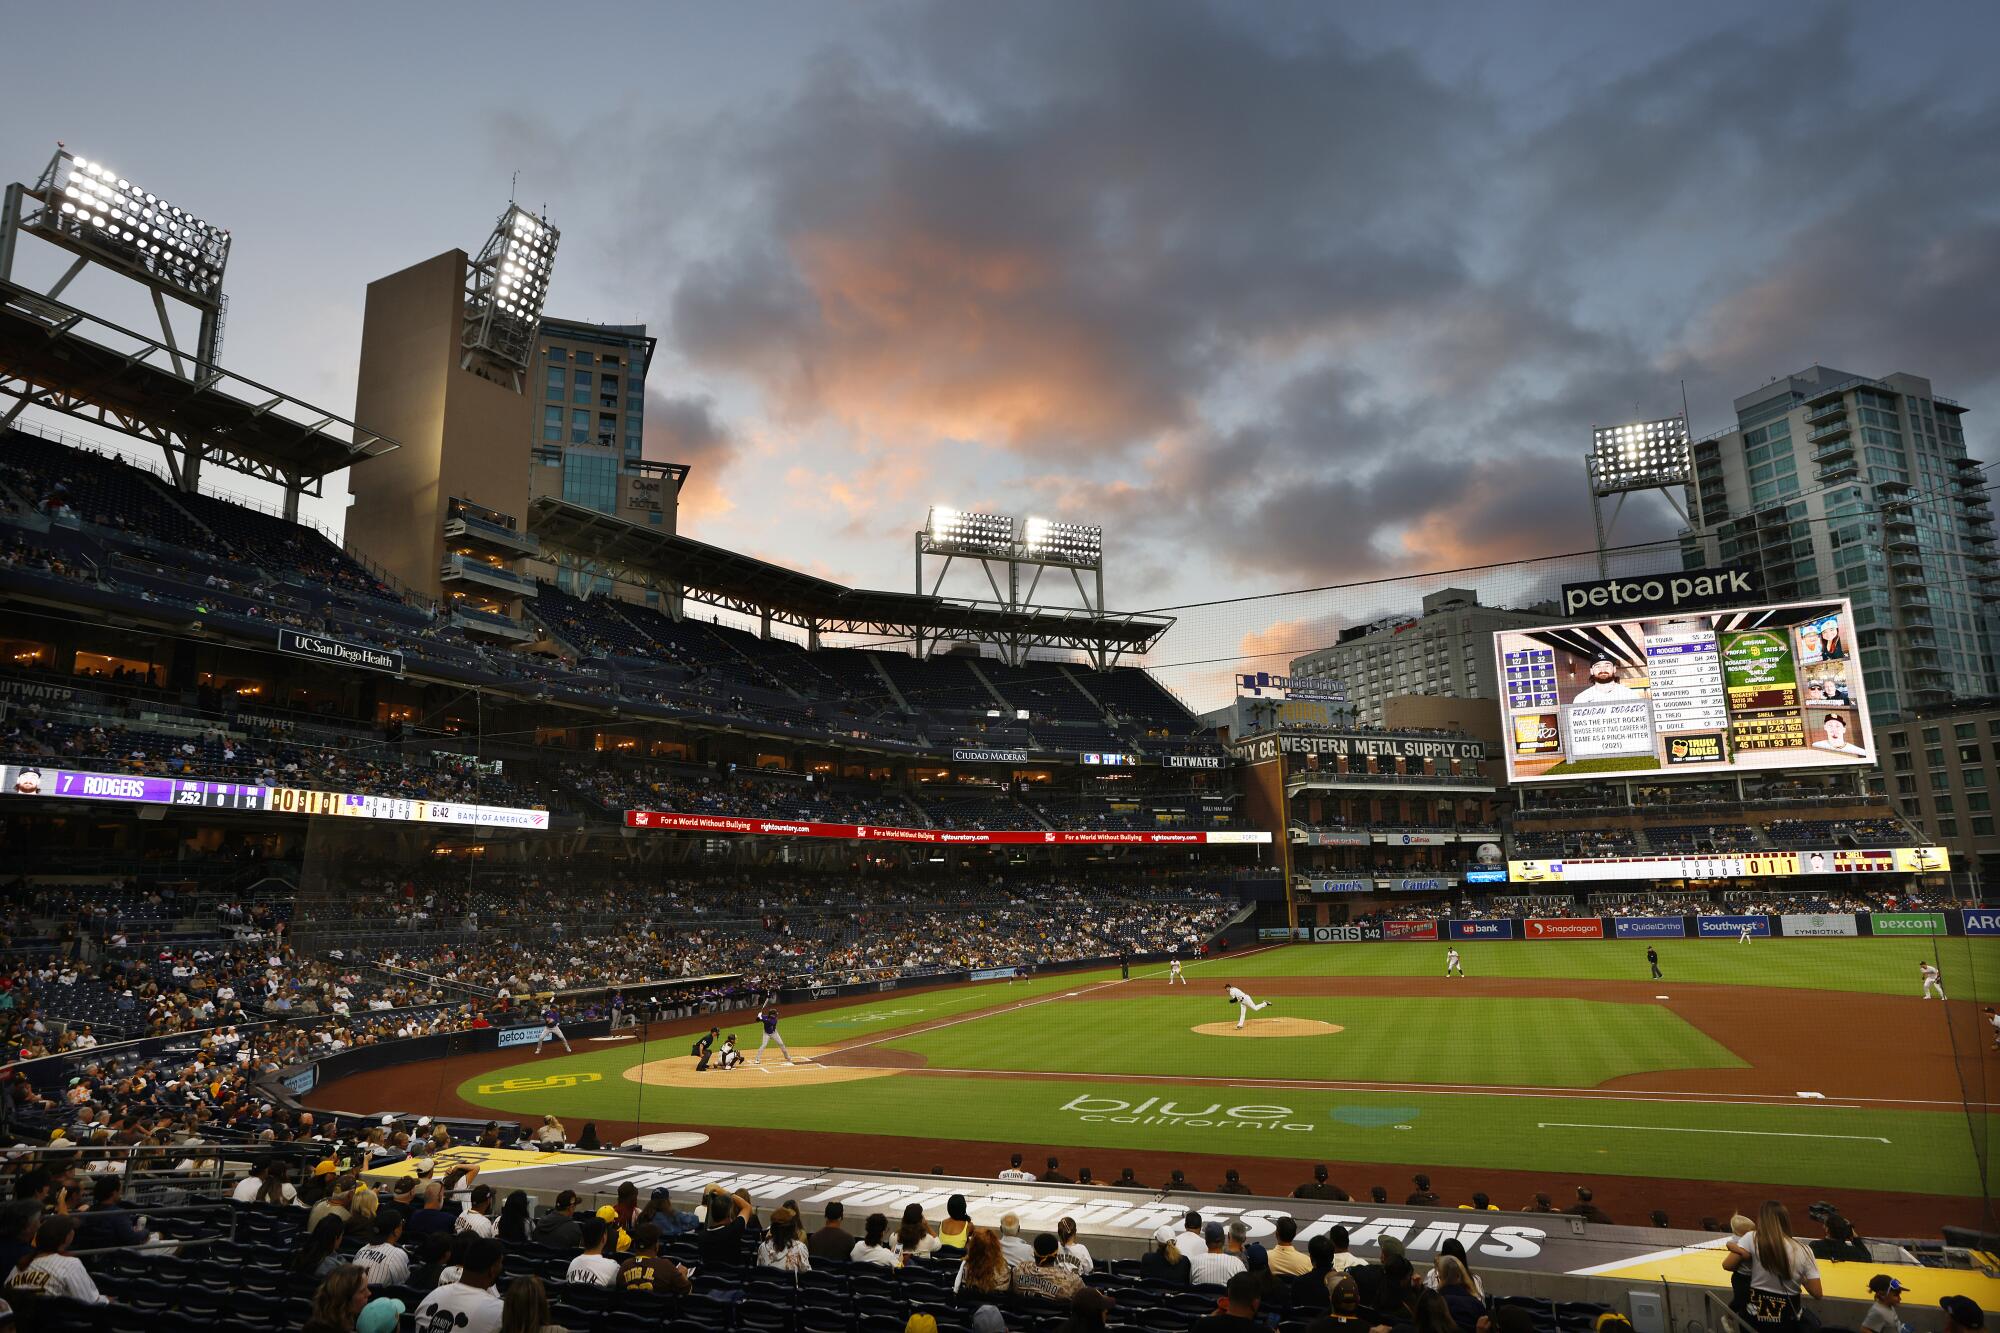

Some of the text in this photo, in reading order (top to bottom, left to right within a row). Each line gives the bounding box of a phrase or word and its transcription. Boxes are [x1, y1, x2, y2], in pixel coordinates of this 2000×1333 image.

[1566, 570, 1752, 615] petco park
[295, 636, 393, 668] UC San Diego Health
[1573, 706, 1606, 716] BRENDAN
[237, 713, 296, 731] CUTWATER
[1280, 736, 1484, 758] WESTERN METAL SUPPLY CO.
[1688, 738, 1716, 747] TRULY
[1260, 740, 1278, 758] CO.
[956, 751, 1026, 762] CIUDAD MADERAS
[1170, 756, 1219, 768] CUTWATER
[63, 776, 144, 798] 7 RODGERS
[177, 792, 200, 804] .252
[216, 794, 224, 806] 0
[246, 796, 256, 808] 14
[274, 790, 340, 814] B 0 S 1 1
[372, 808, 410, 820] 0 0 0
[382, 802, 386, 812] H
[398, 804, 402, 812] E
[419, 806, 423, 818] 1
[432, 806, 449, 818] 6:42
[458, 812, 480, 820] BANK
[493, 814, 528, 824] AMERICA
[660, 816, 672, 824] For
[678, 818, 698, 826] World
[700, 819, 725, 828] Without
[726, 822, 750, 830] Bullying
[760, 824, 810, 833] rightourstory.com
[918, 832, 934, 840] Bullying
[1751, 860, 1793, 874] 0 1 1
[1365, 929, 1380, 938] 342
[1476, 924, 1498, 933] bank
[1547, 924, 1598, 934] Snapdragon
[1632, 923, 1681, 932] QuidelOrtho
[1316, 928, 1359, 940] ORIS
[500, 1031, 525, 1045] petco
[1059, 1094, 1294, 1118] blue
[1080, 1115, 1314, 1132] california
[800, 1180, 977, 1212] YOU
[1293, 1213, 1546, 1258] FANS
